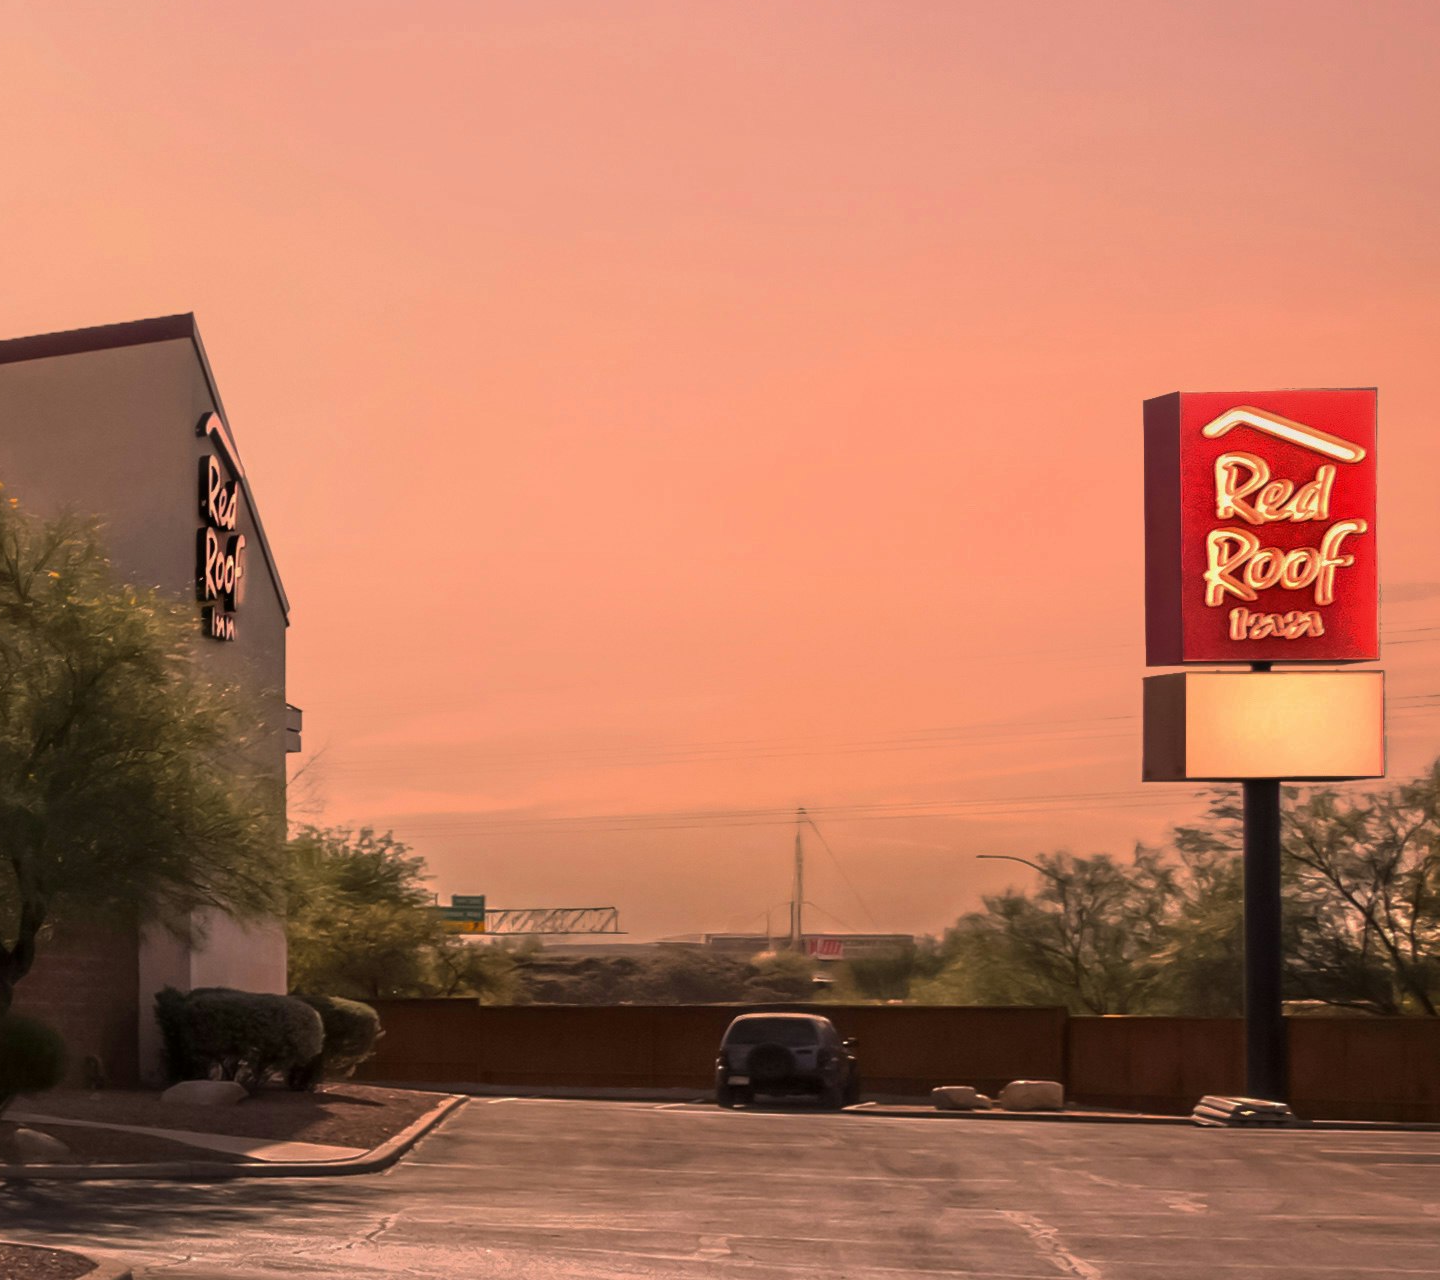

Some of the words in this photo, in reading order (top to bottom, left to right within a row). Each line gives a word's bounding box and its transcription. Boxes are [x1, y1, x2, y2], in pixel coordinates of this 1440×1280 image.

[205, 455, 239, 530] Red
[1214, 451, 1336, 524] Red
[201, 526, 246, 610] Roof
[1203, 519, 1368, 607] Roof
[208, 606, 236, 641] Inn
